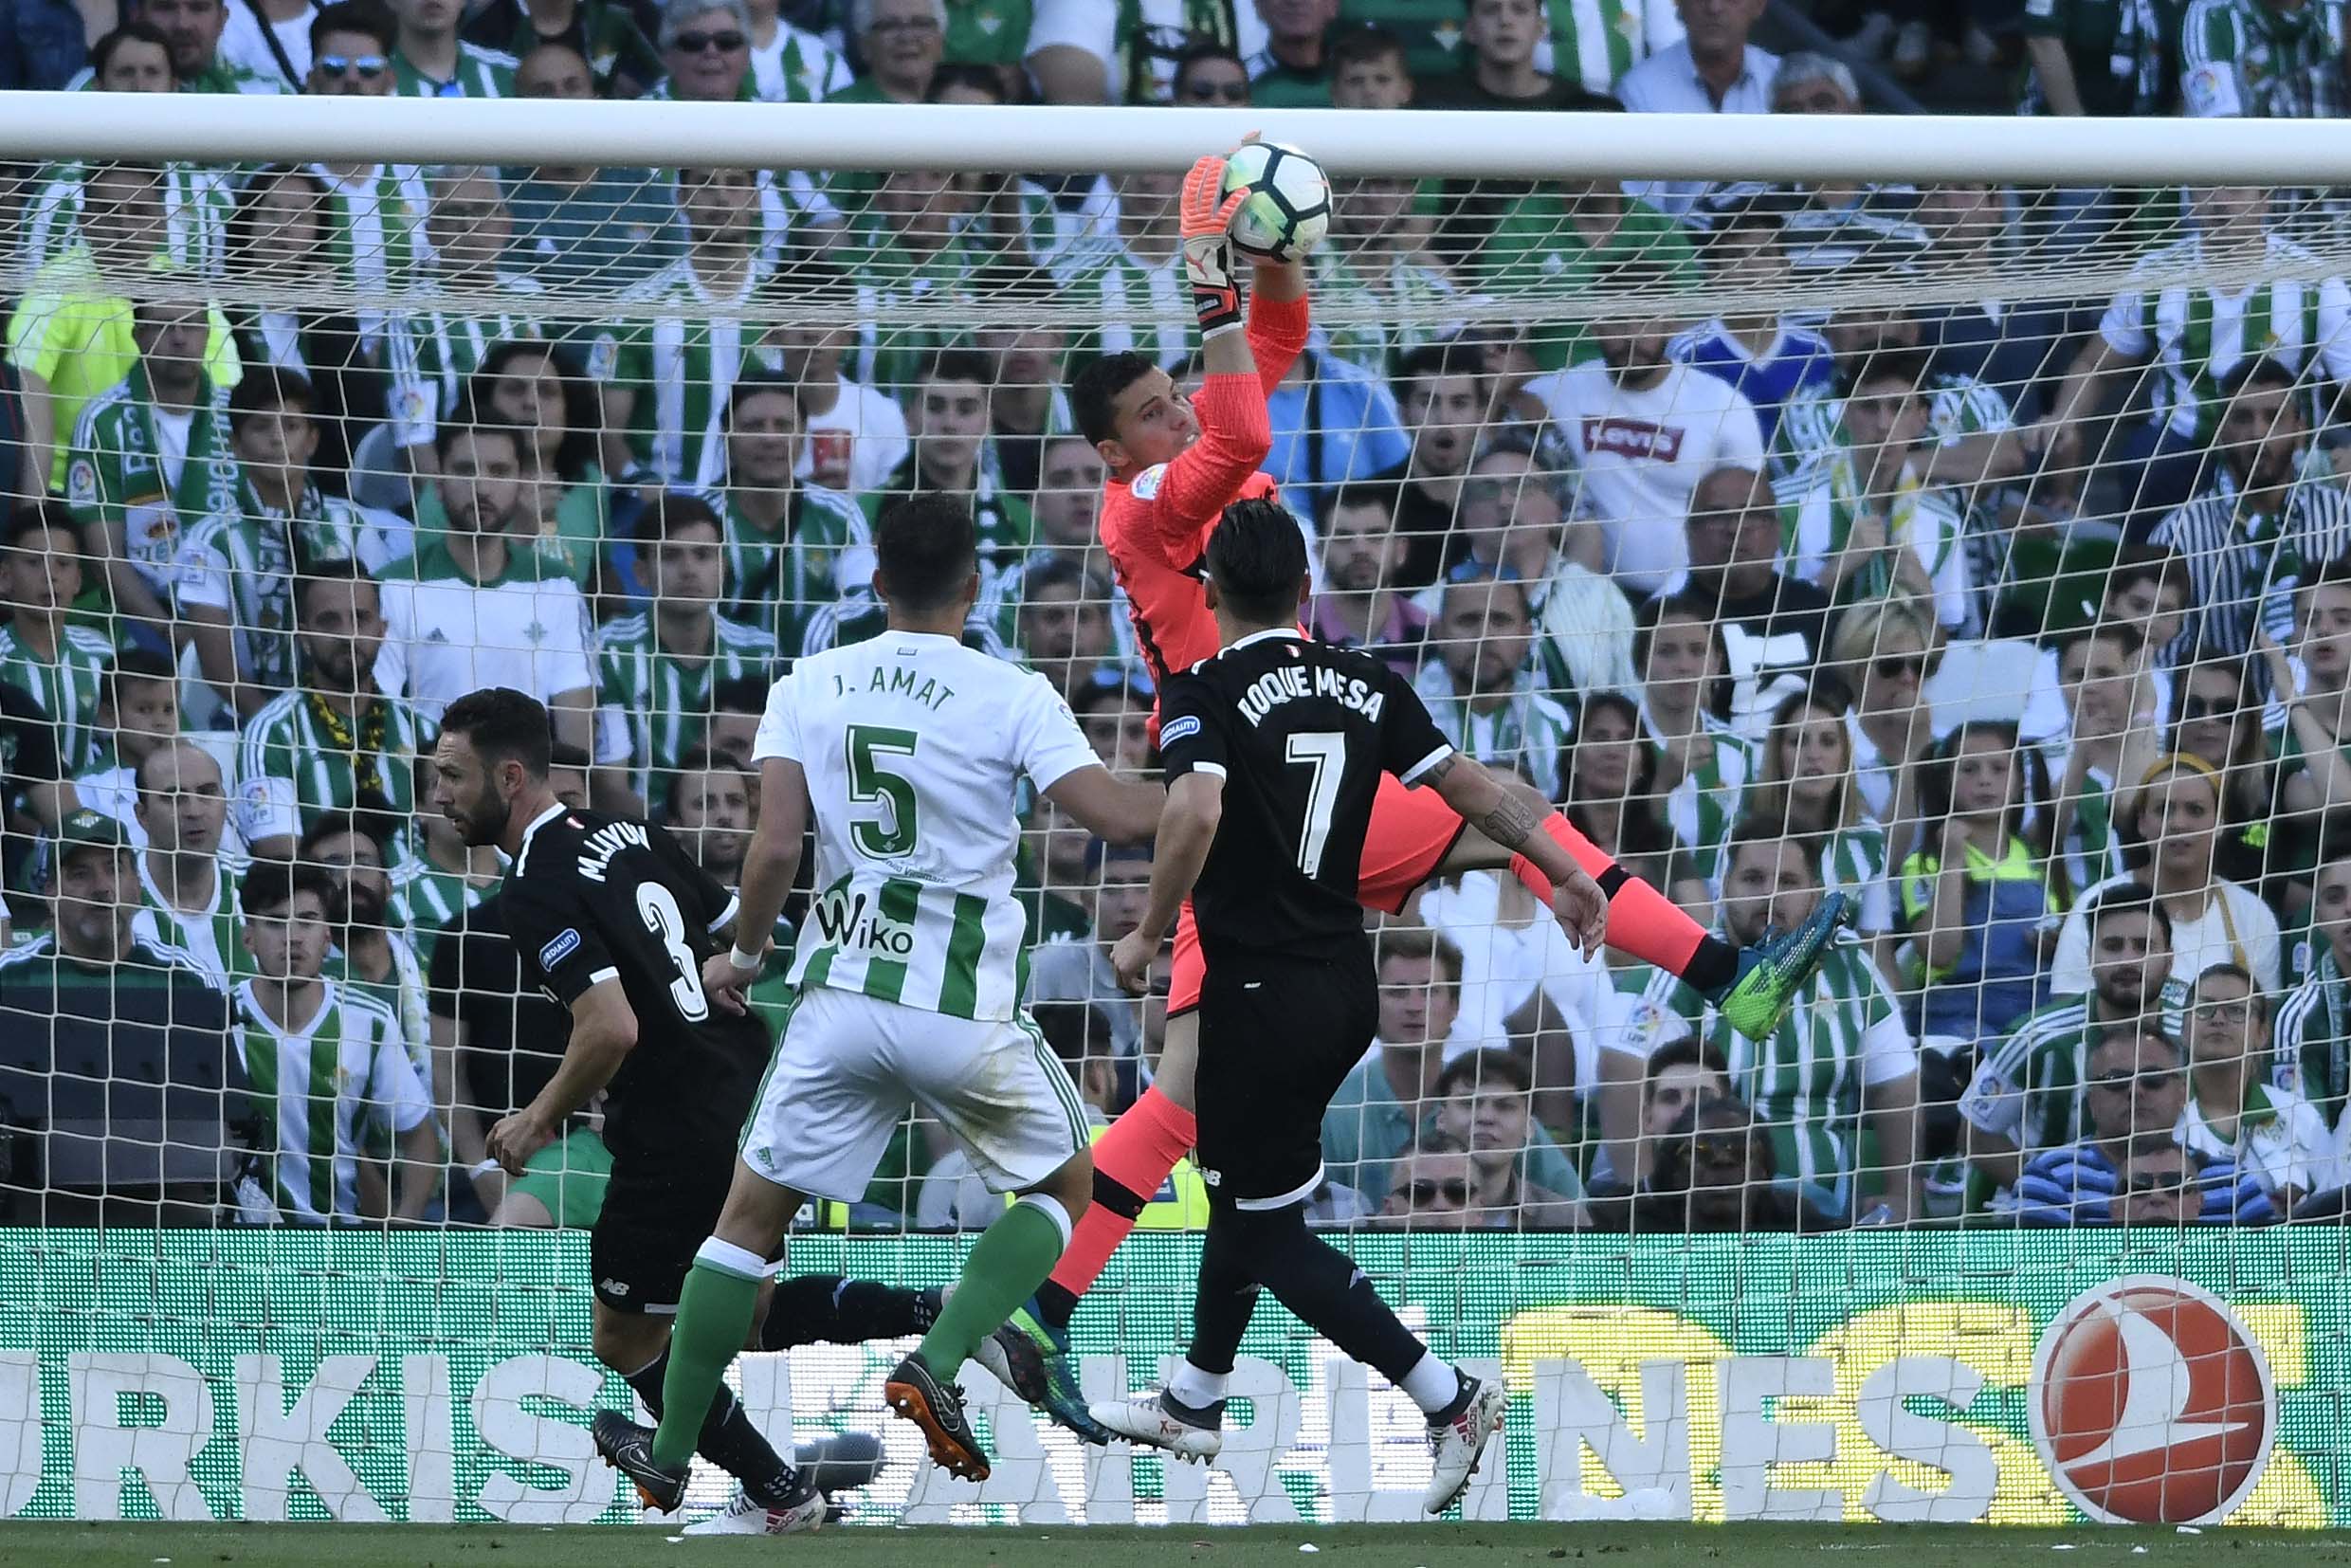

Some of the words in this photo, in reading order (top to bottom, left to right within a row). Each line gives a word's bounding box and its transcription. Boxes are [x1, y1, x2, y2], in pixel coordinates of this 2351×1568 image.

[834, 675, 856, 698] J.
[870, 666, 956, 711] AMAT
[1237, 665, 1311, 728] ROQUE
[1316, 665, 1385, 723] MESA
[845, 724, 919, 861] 5
[1285, 732, 1346, 880] 7
[636, 881, 709, 1022] 3
[815, 893, 914, 955] Wiko
